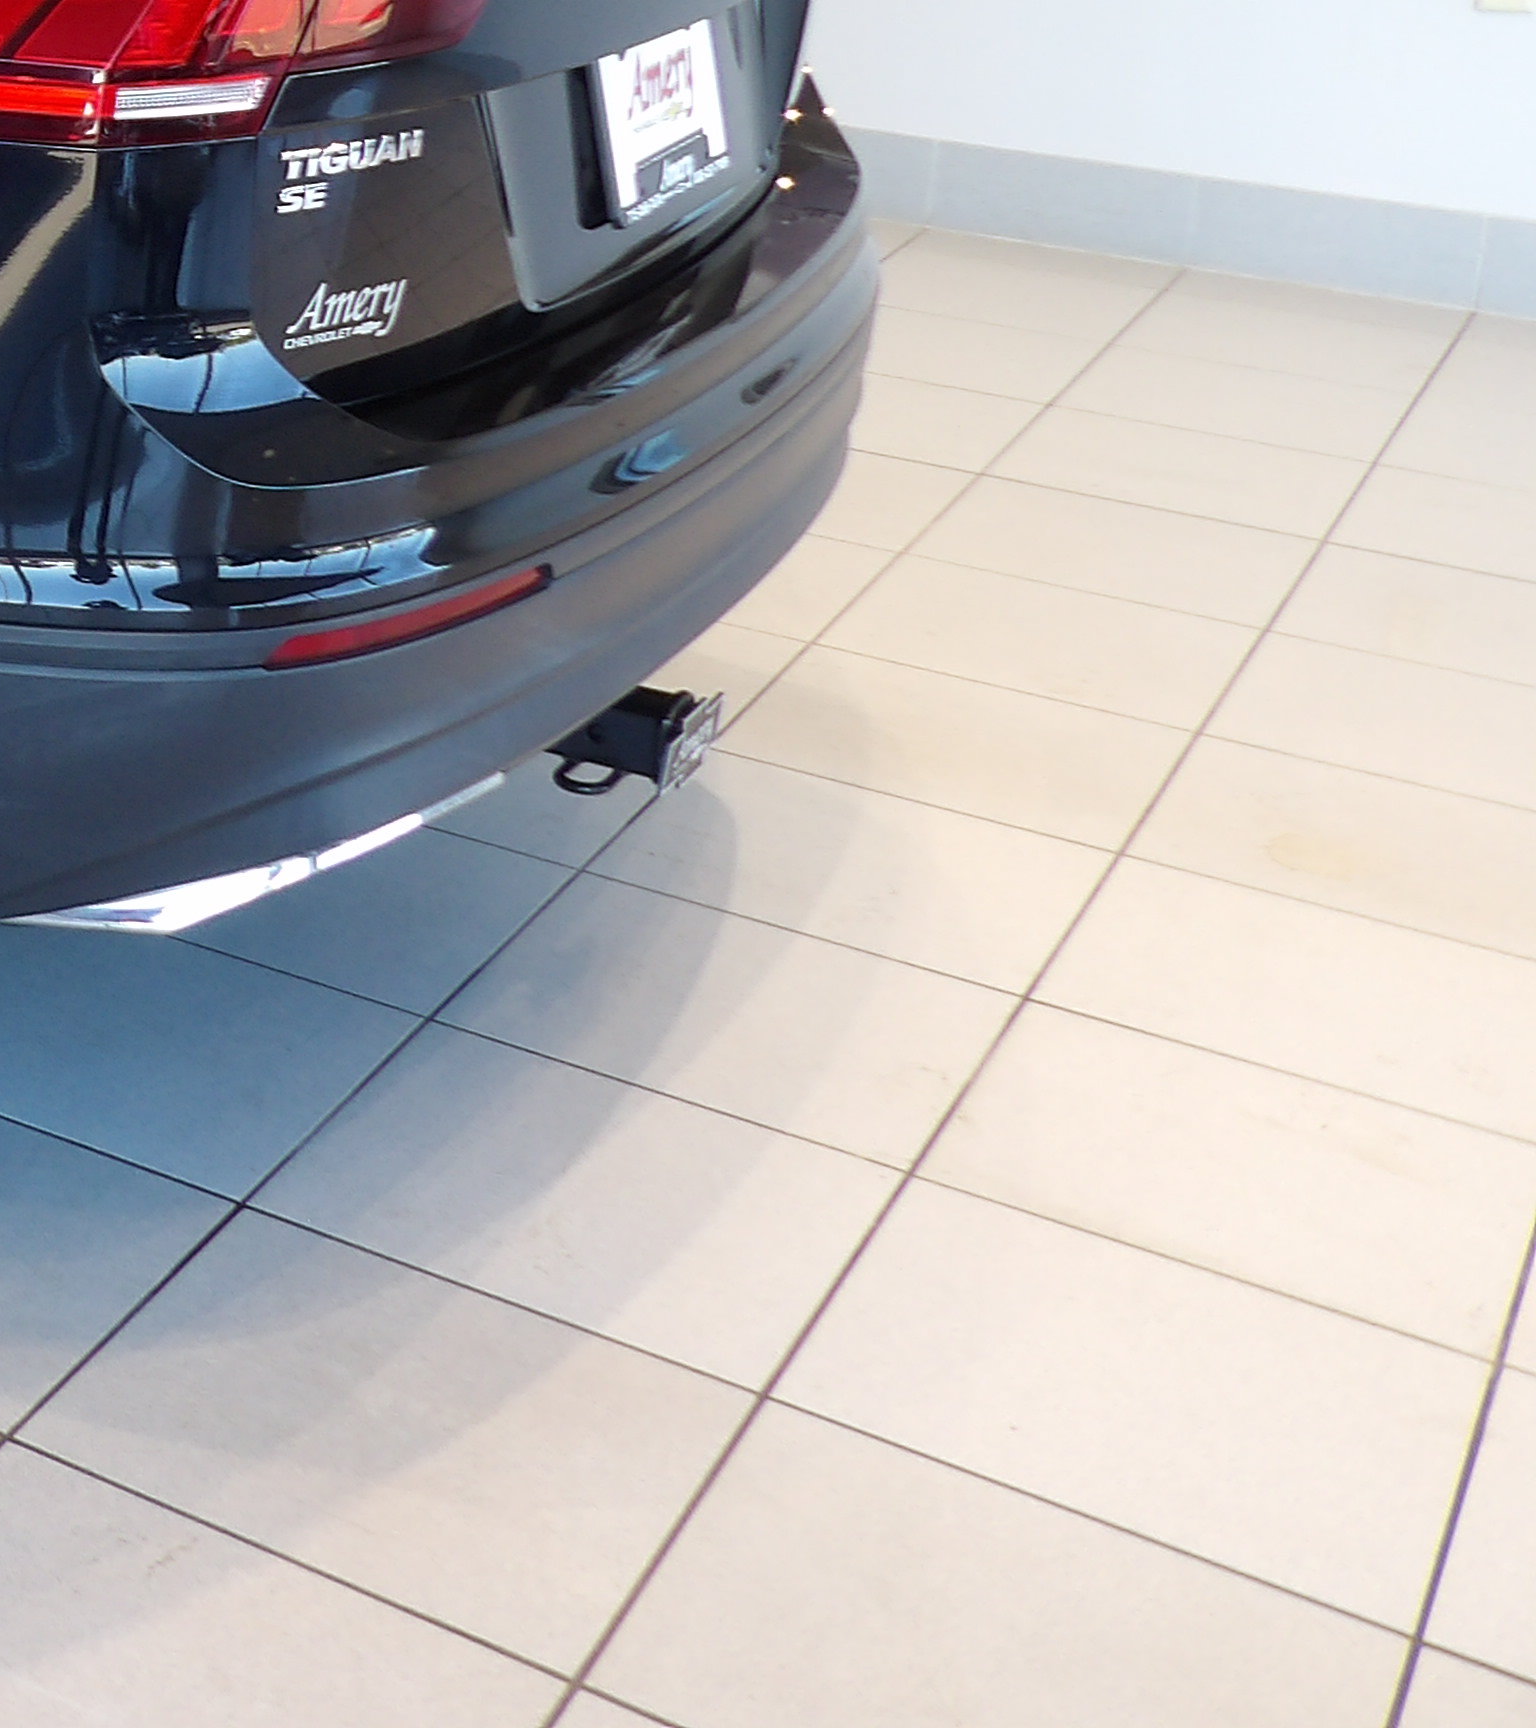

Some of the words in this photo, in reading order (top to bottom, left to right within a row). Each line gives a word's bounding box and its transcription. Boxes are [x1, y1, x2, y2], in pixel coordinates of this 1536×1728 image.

[280, 128, 425, 180] TIGUAN
[276, 182, 328, 214] SE
[285, 278, 409, 337] Amery
[282, 325, 353, 350] CHEVROLET
